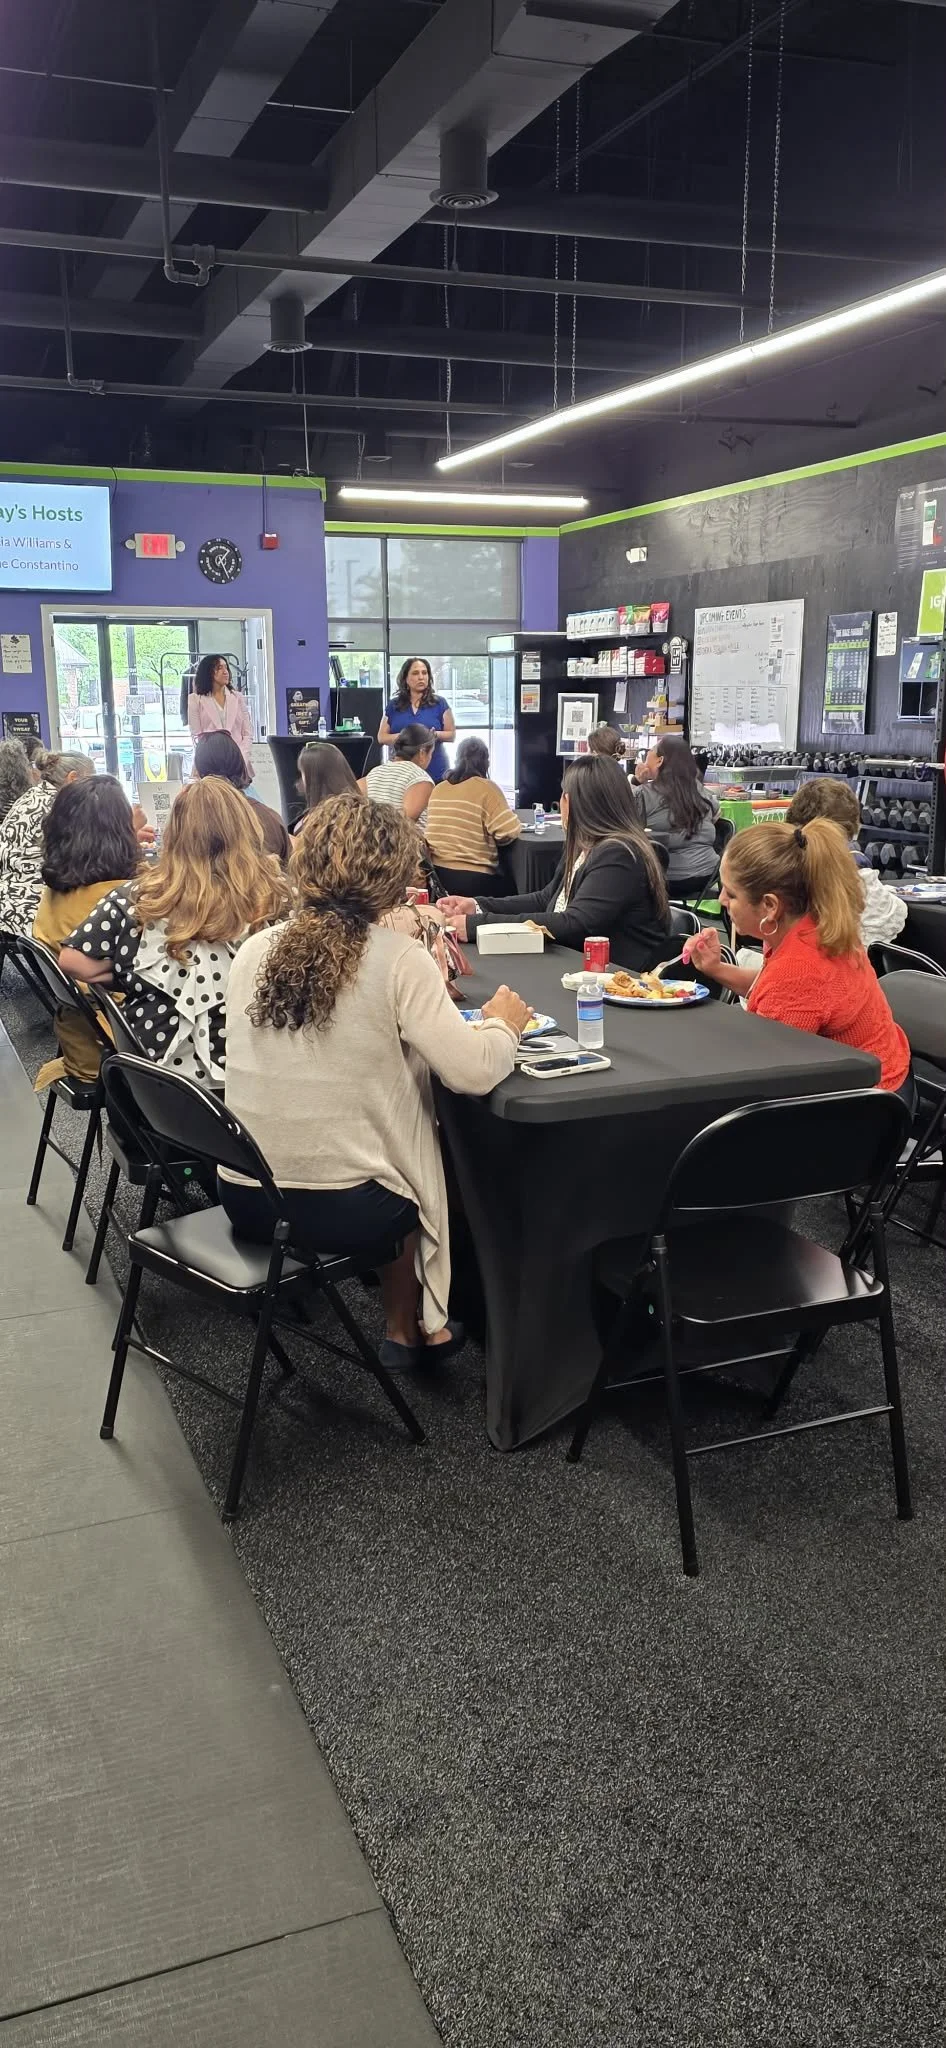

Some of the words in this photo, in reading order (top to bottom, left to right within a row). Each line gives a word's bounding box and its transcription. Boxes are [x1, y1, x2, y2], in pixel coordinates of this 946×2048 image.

[32, 505, 83, 521] Hosts
[12, 536, 61, 549] Williams
[63, 539, 72, 549] &
[11, 558, 79, 571] Constantino
[725, 609, 747, 621] EVENTS
